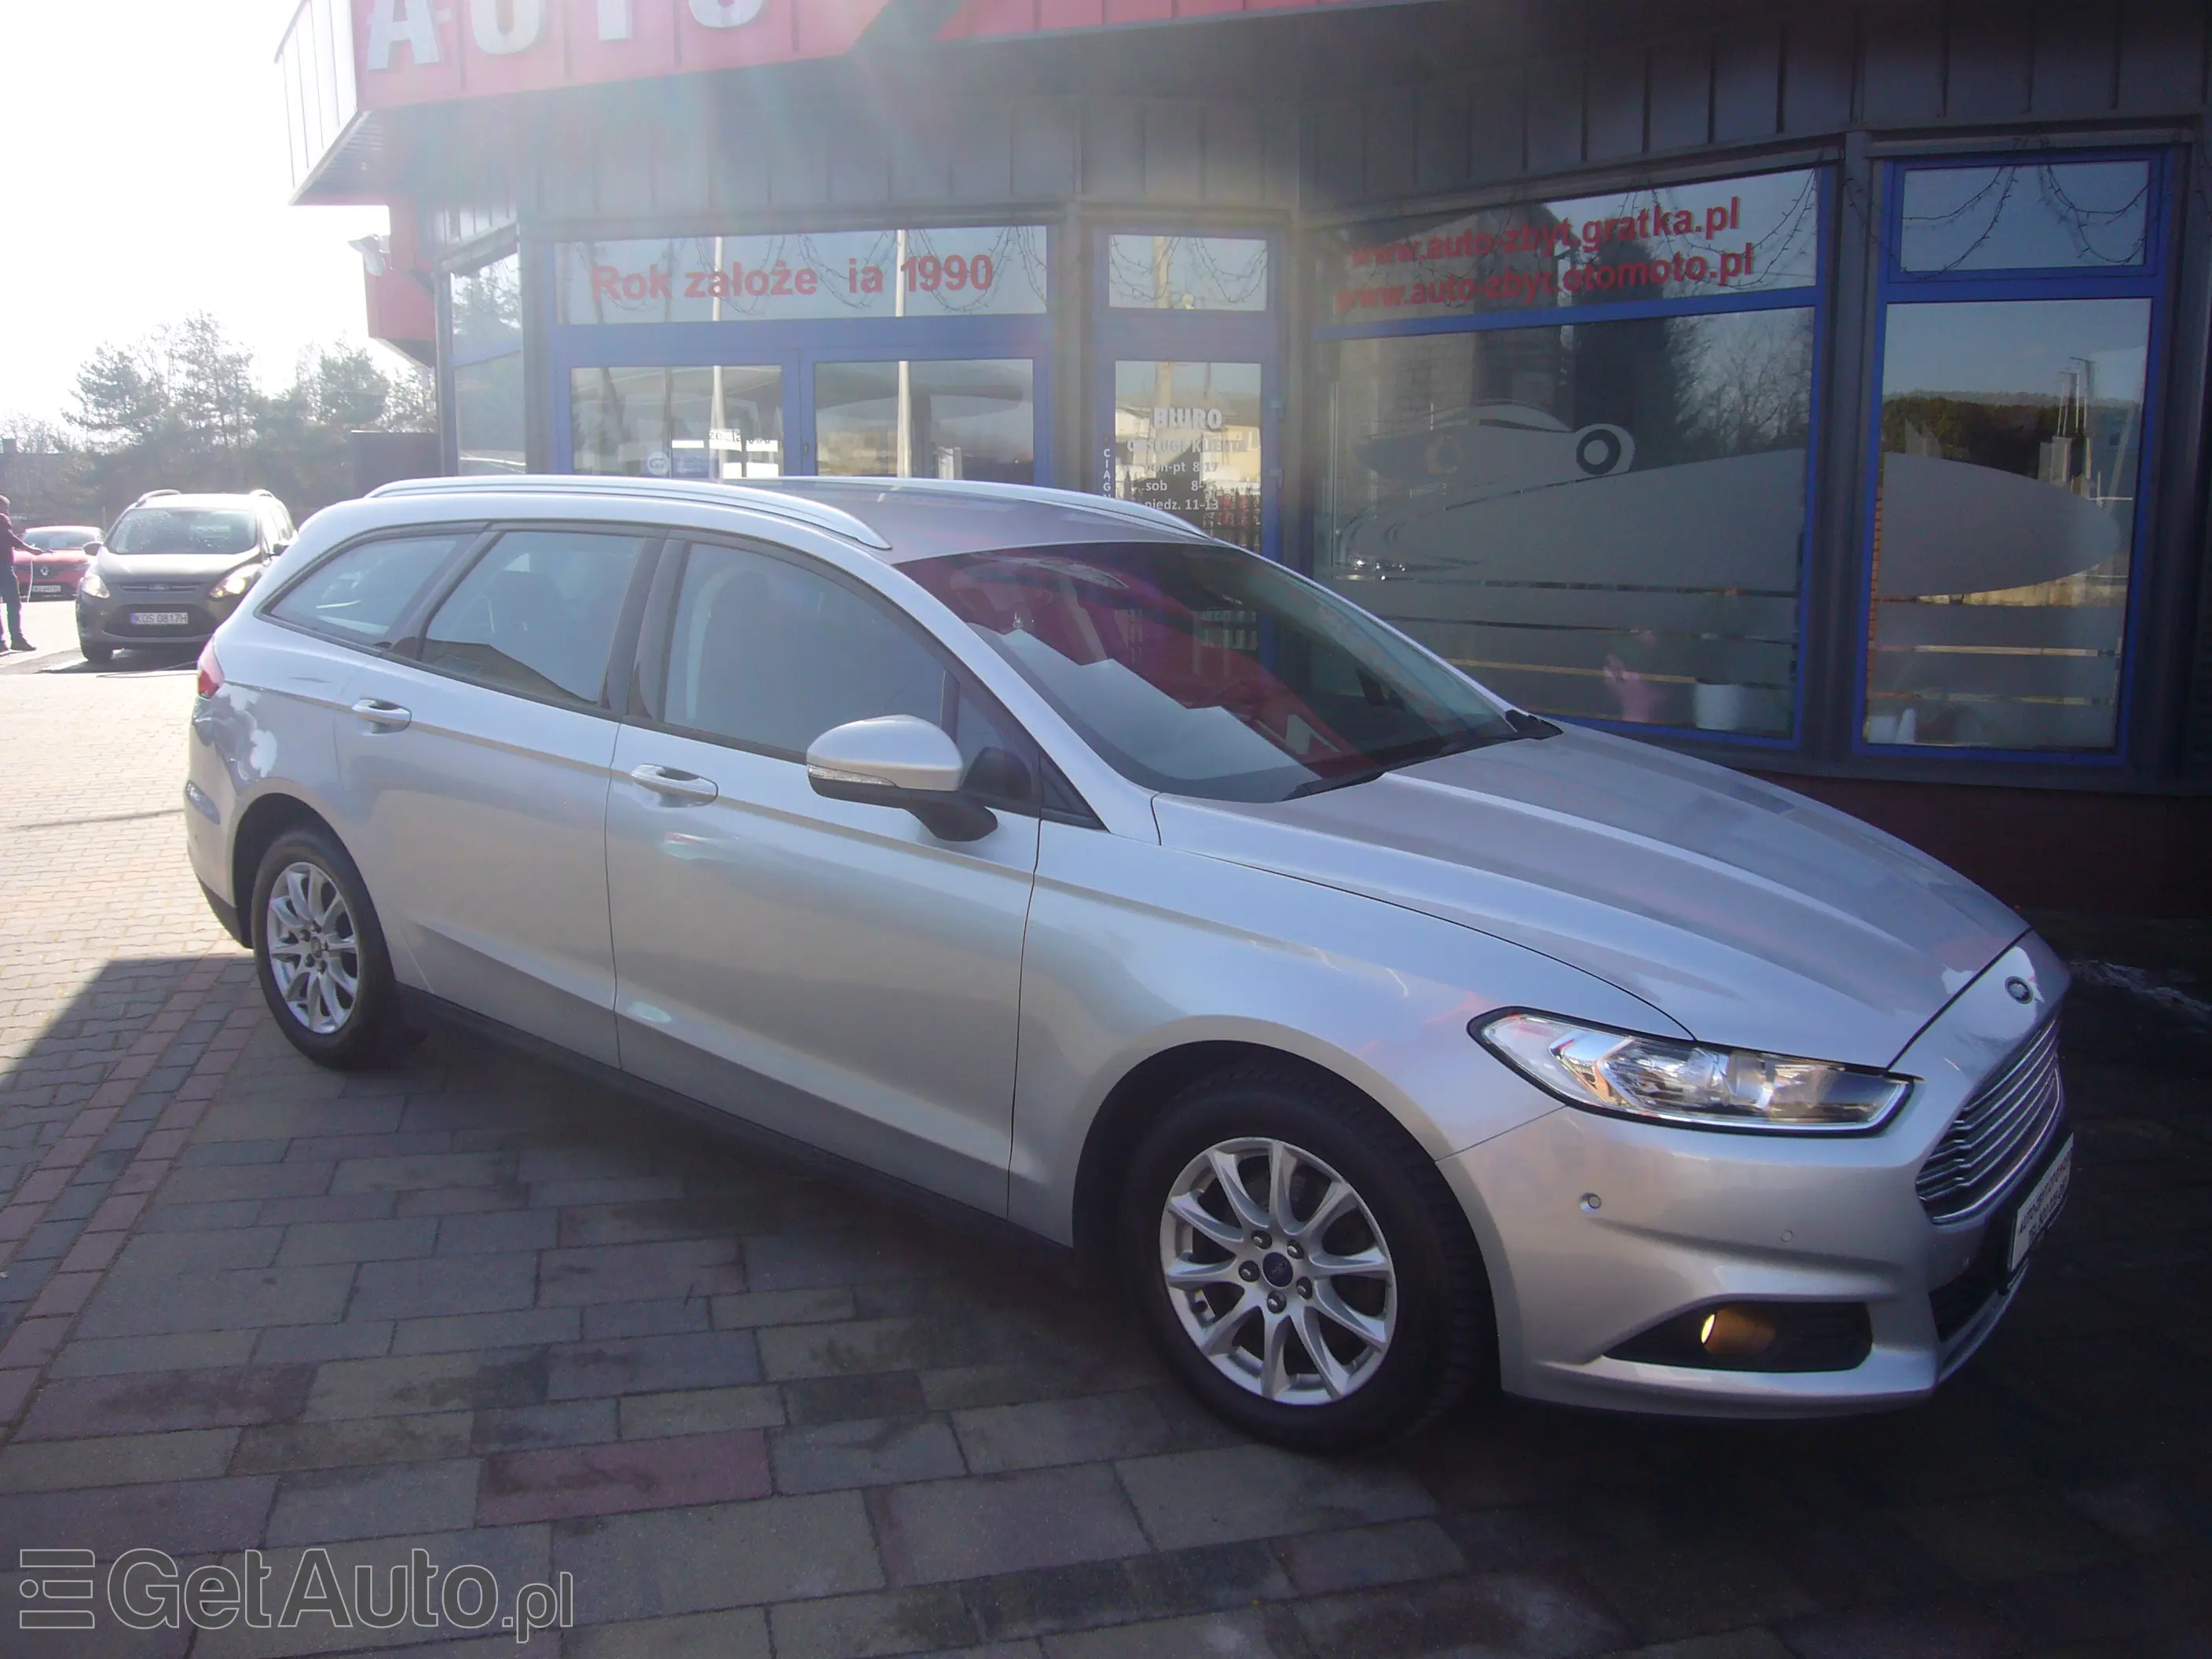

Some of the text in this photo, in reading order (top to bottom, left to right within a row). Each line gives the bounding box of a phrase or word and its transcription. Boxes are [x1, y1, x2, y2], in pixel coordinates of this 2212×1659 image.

[1351, 196, 1739, 267] www.auto-zbyt.gratka.pl
[591, 265, 673, 300] Rok
[901, 254, 994, 292] 1990
[1336, 243, 1754, 310] www.auto-zbyt.otomoto.pl
[1153, 407, 1223, 430] BIURO
